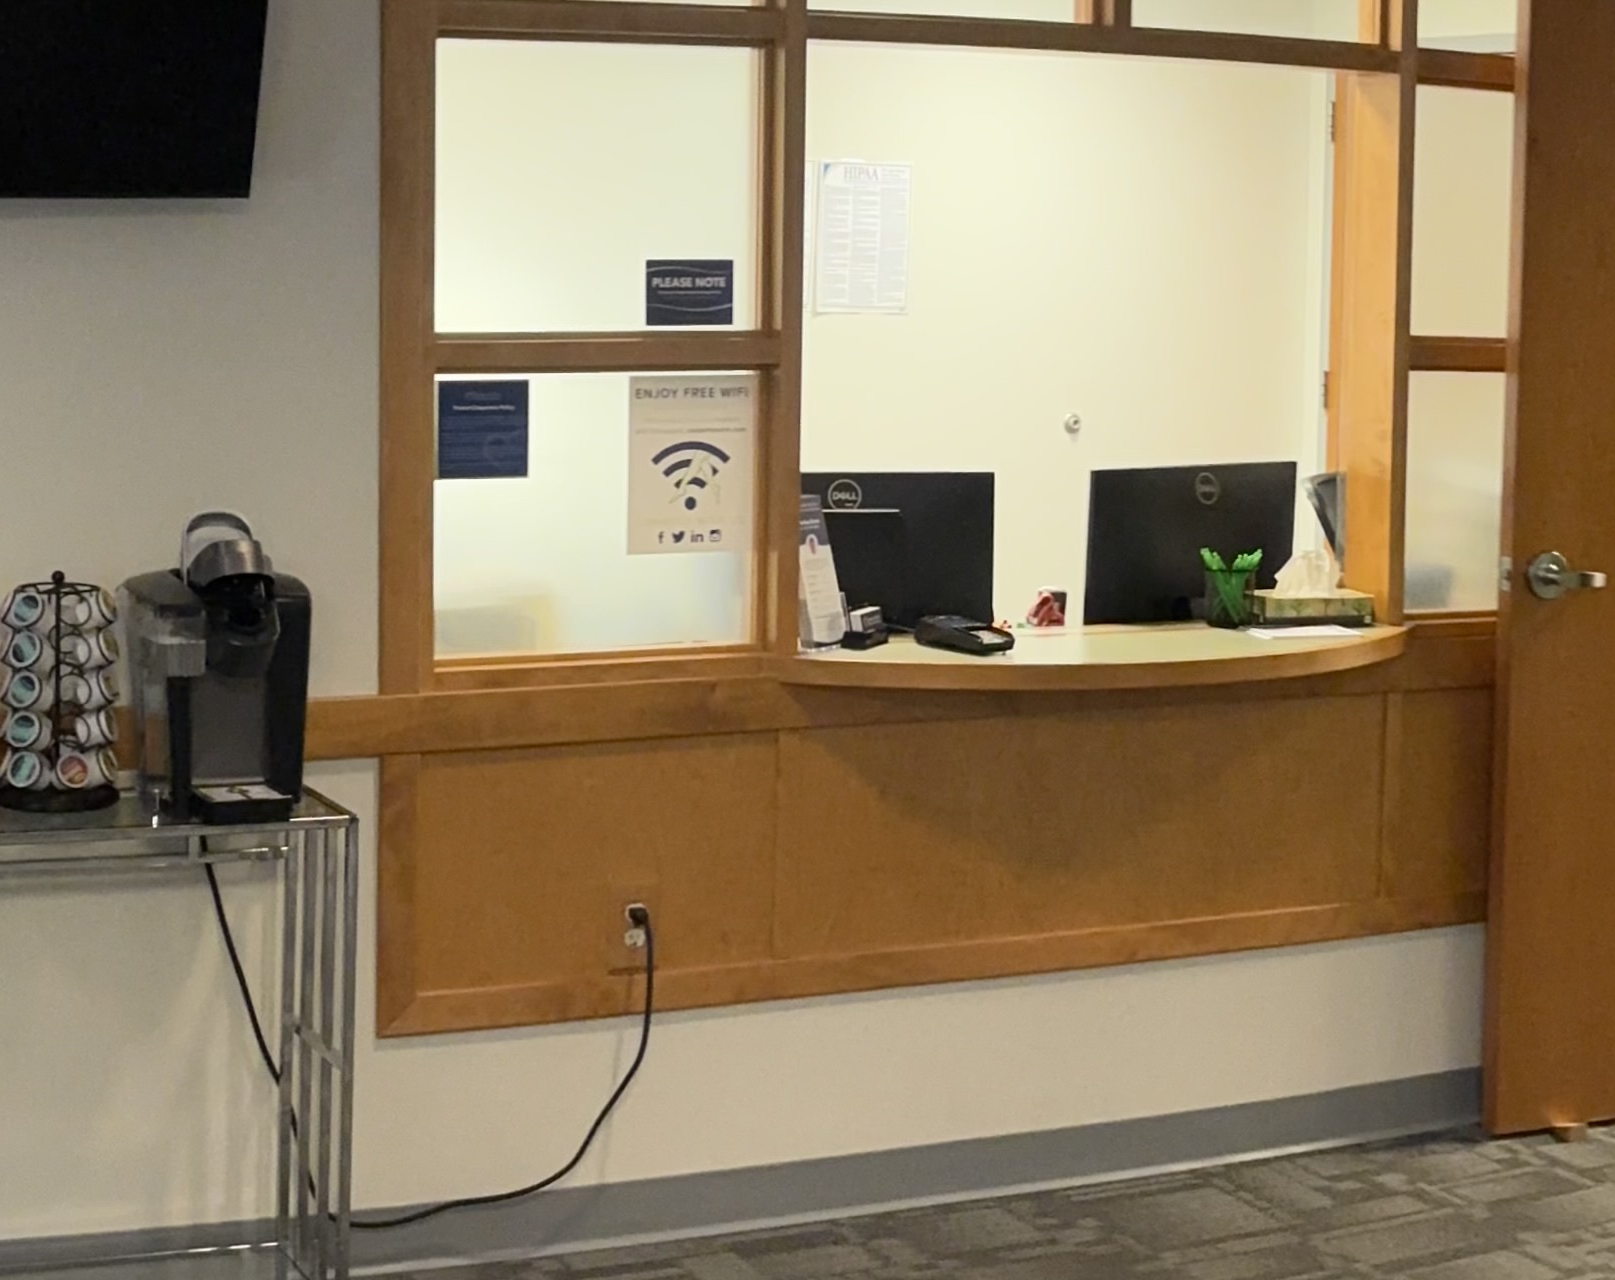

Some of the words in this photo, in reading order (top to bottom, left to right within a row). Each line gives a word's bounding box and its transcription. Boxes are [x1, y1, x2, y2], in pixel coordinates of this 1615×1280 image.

[651, 277, 693, 288] PLEASE
[695, 277, 726, 288] NOTE
[635, 387, 679, 399] ENJOY
[683, 387, 716, 398] FREE
[720, 386, 749, 397] WIFI
